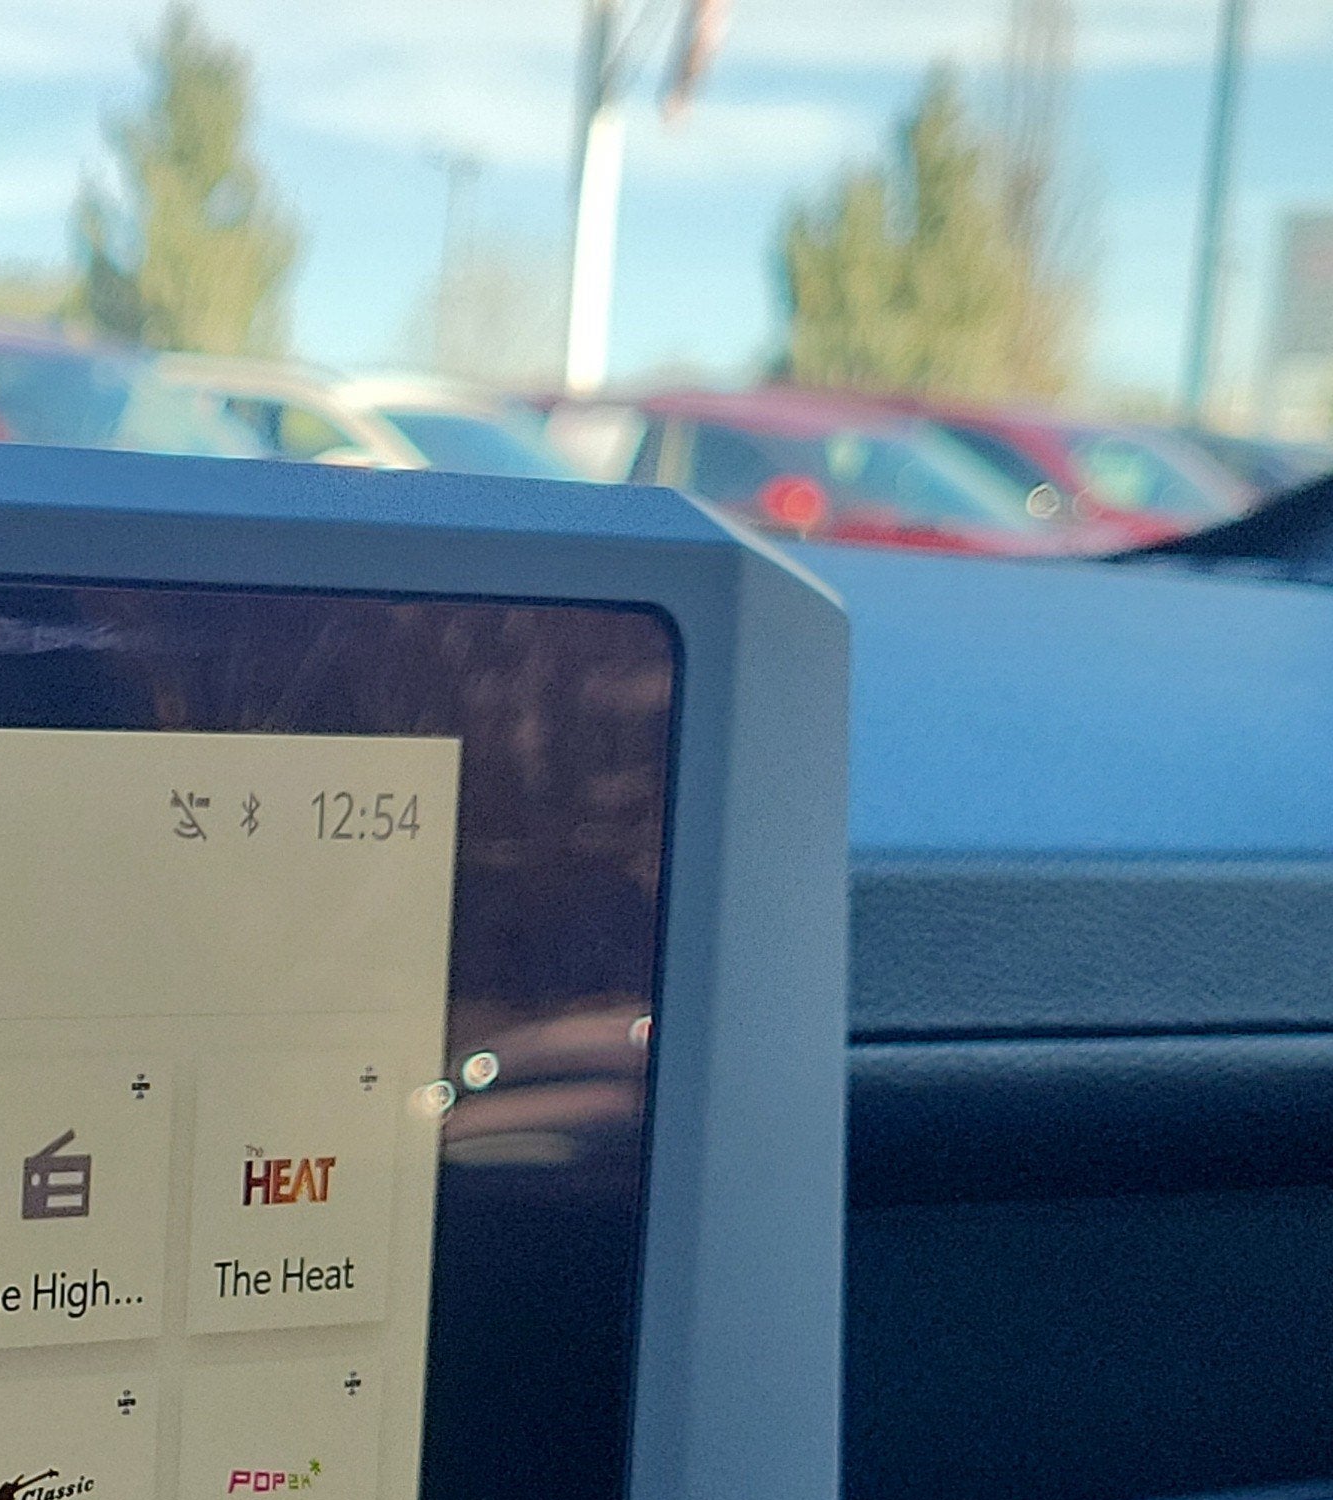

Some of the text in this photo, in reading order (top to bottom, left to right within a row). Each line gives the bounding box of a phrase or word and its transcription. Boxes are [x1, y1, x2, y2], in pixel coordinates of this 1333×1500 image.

[310, 791, 421, 841] 12:54
[242, 1157, 337, 1206] HEAT
[32, 1271, 144, 1318] High...
[214, 1256, 355, 1299] The Heat
